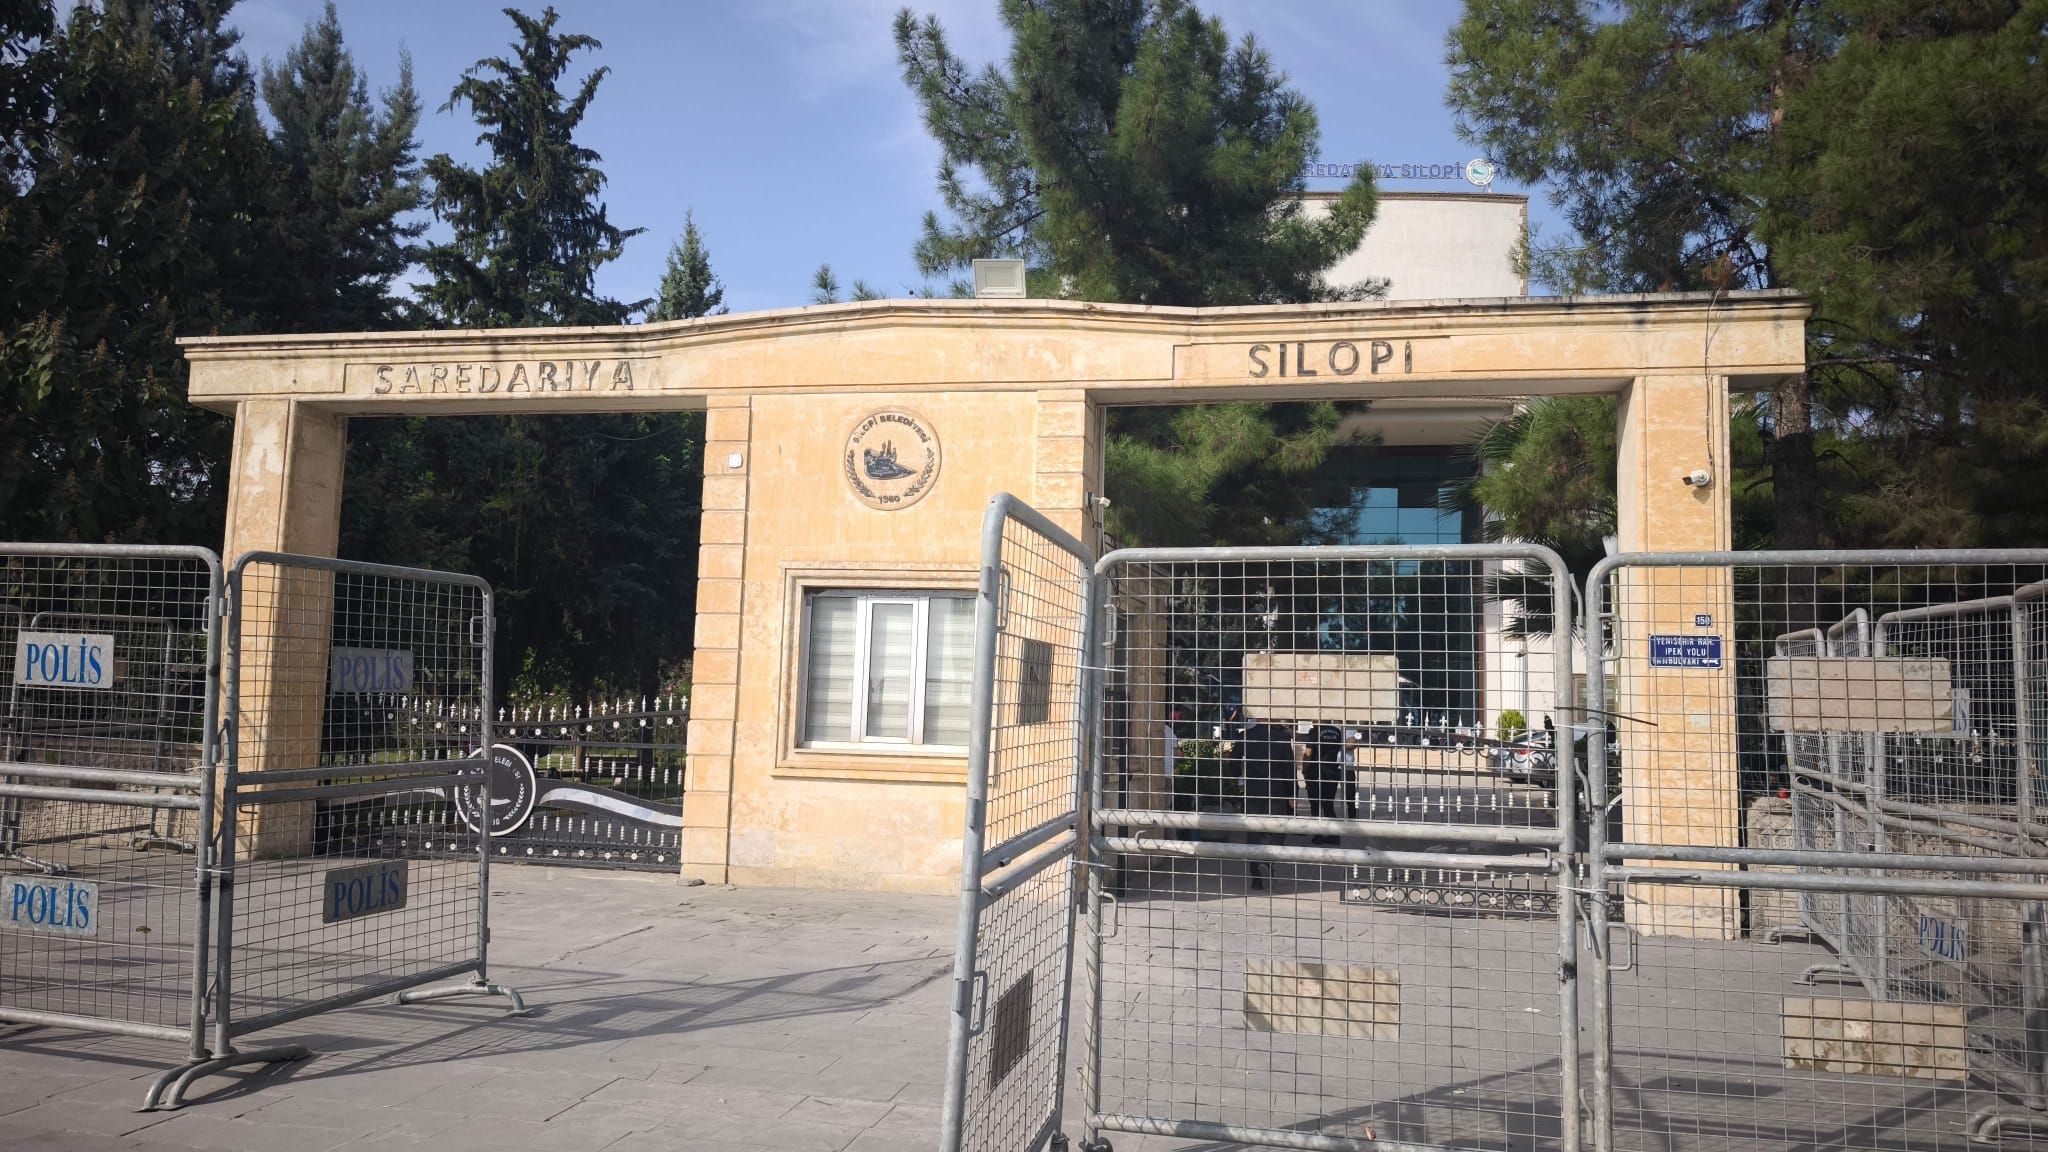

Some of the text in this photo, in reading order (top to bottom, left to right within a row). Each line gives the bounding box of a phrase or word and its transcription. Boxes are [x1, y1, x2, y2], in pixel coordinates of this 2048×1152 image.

[375, 360, 634, 394] SAREDARIYA
[1697, 616, 1711, 625] 150
[25, 637, 102, 684] POLİS
[338, 648, 404, 692] POLİS
[1686, 647, 1706, 657] YOLU
[12, 882, 89, 928] POLİS
[333, 865, 399, 918] POLİS
